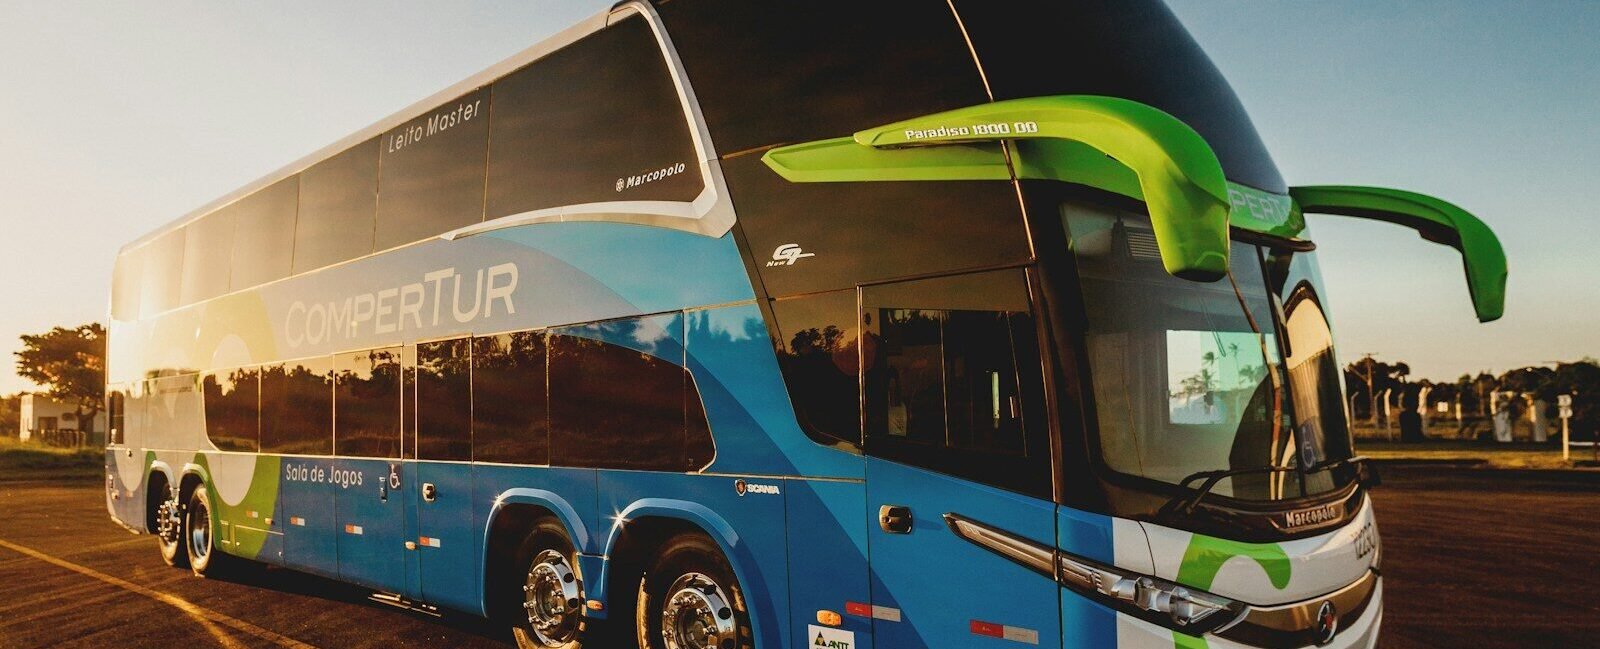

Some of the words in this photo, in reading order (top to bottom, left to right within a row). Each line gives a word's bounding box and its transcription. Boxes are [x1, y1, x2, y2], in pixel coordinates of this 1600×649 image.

[388, 126, 423, 153] Leito
[426, 100, 481, 137] Master
[905, 126, 970, 140] Paradiso
[626, 162, 686, 189] Marcopolo
[285, 262, 519, 348] COMPERTUR
[310, 466, 325, 483] de
[328, 465, 363, 489] Jogos
[747, 484, 780, 494] SCANIA
[1286, 505, 1336, 528] Marcopolo
